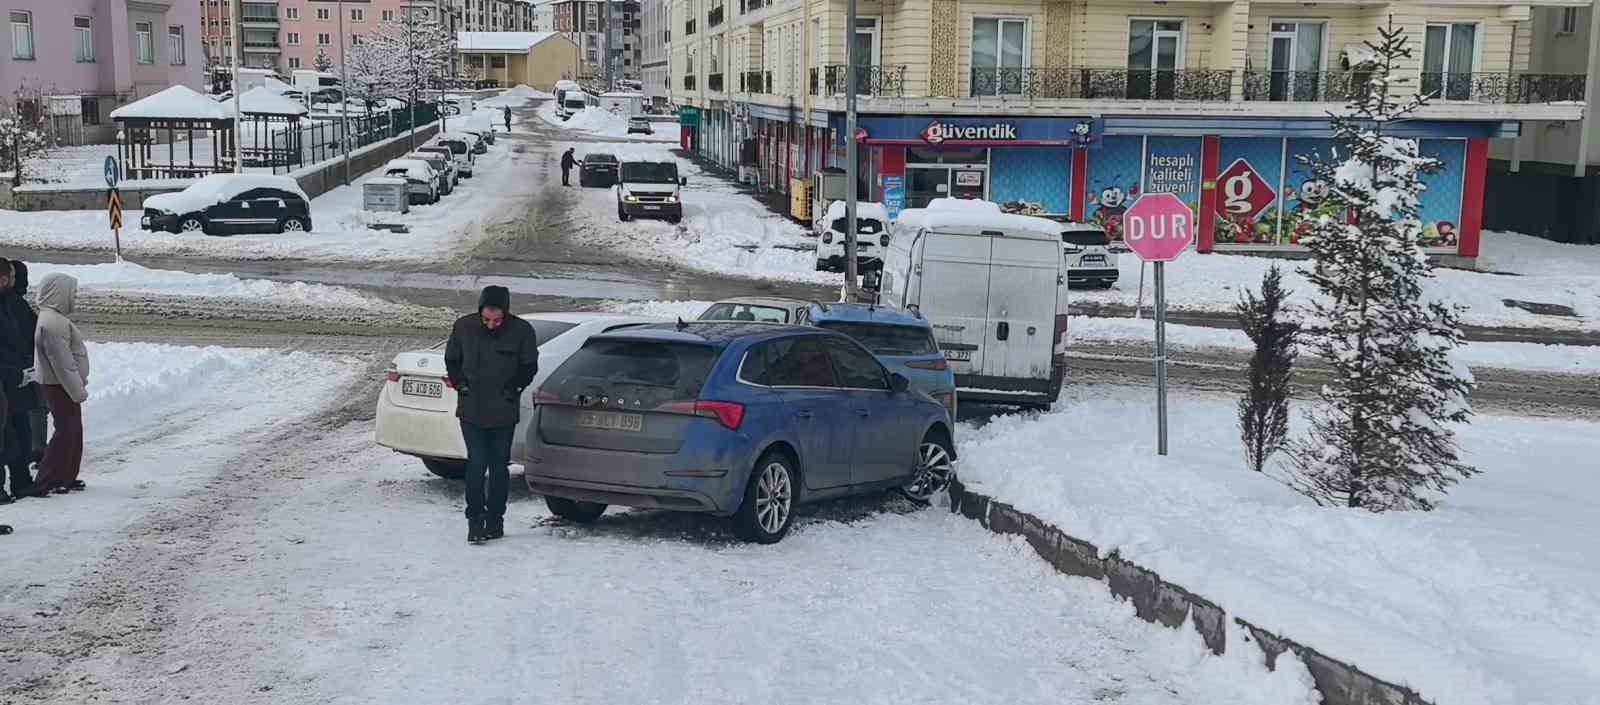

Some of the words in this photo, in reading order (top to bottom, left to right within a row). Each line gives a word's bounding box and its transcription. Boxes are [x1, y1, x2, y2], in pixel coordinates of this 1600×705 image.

[927, 122, 1017, 143] güvendik
[1151, 154, 1194, 169] hesaplı
[1151, 168, 1193, 181] kaliteli
[1129, 213, 1187, 240] DUR
